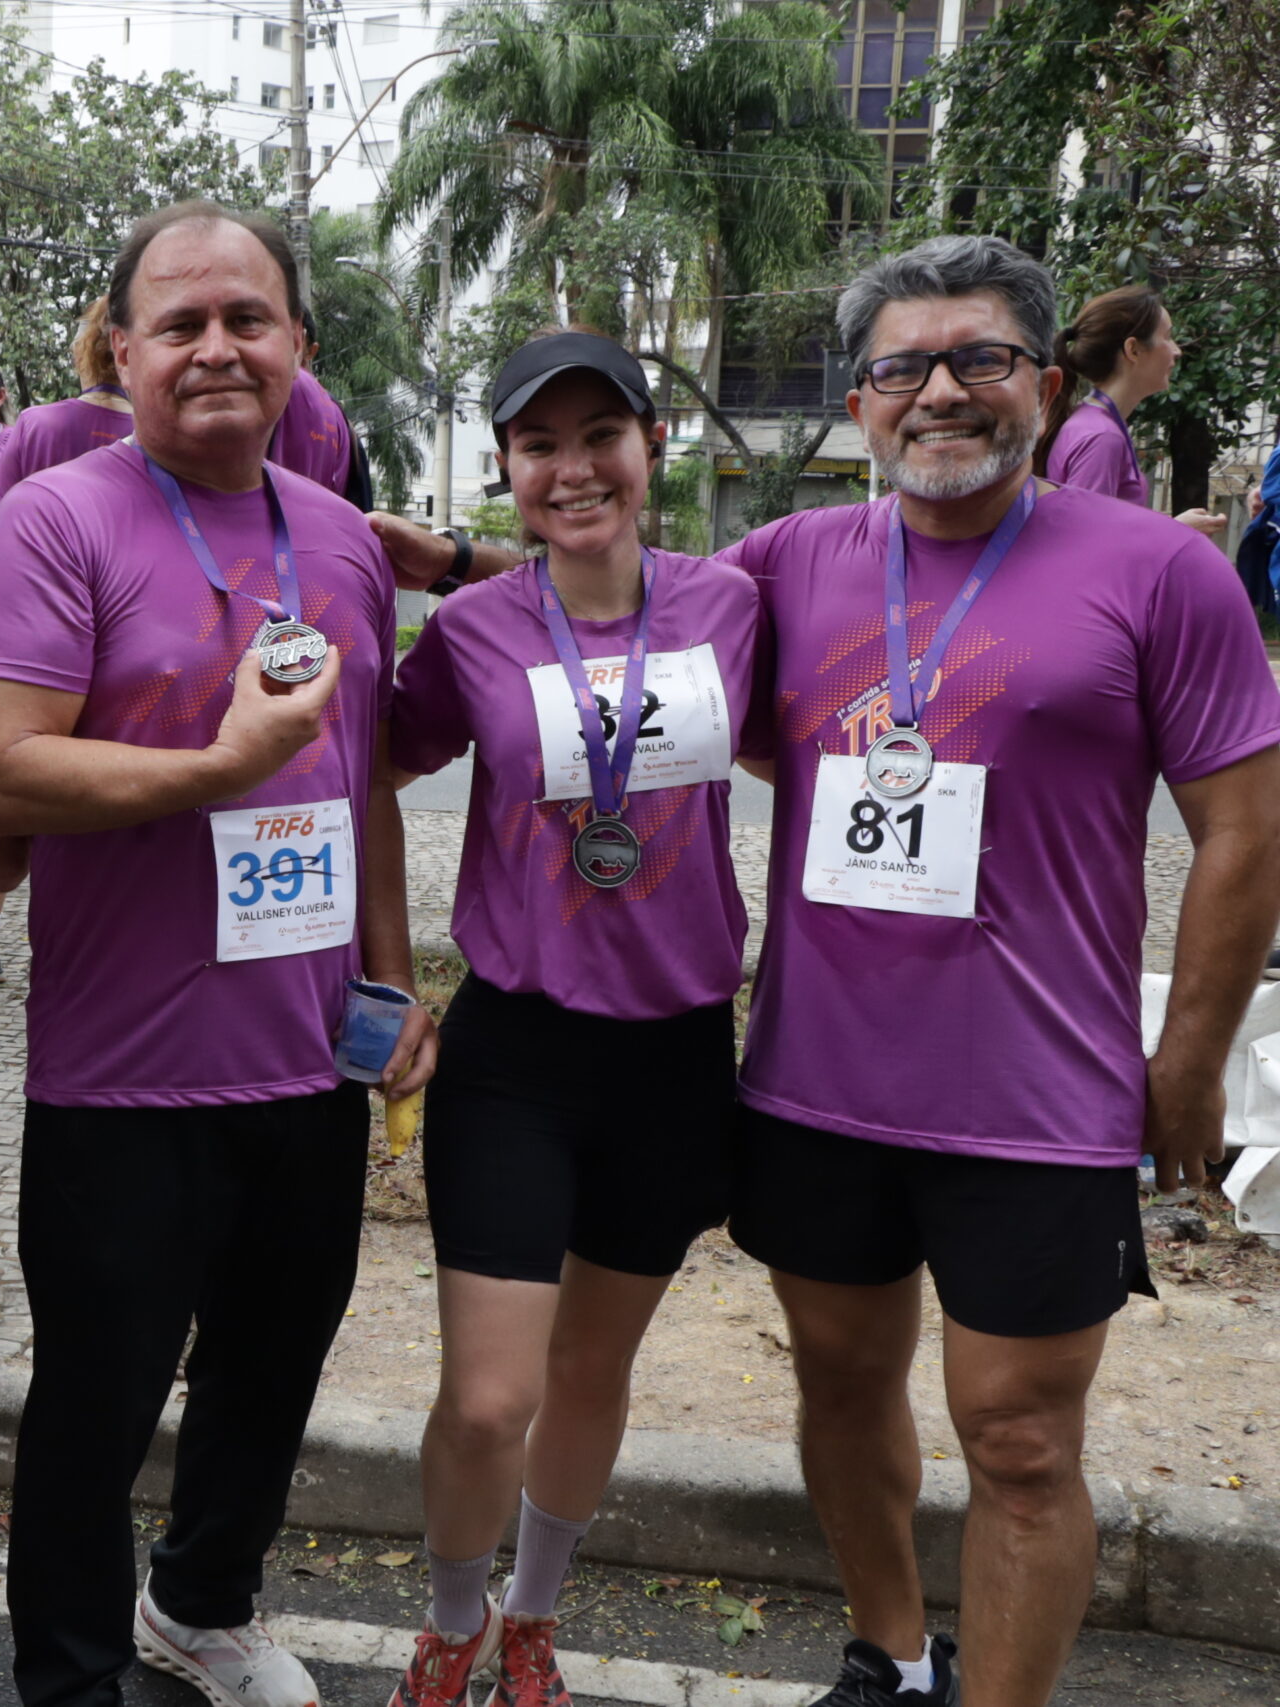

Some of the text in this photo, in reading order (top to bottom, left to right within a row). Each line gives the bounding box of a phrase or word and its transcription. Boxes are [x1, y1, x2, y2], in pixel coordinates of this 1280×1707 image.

[259, 638, 328, 671] TRF6
[847, 686, 880, 712] corrida
[937, 788, 957, 797] 5KM
[254, 815, 315, 841] TRF6
[846, 799, 924, 859] 81
[227, 842, 334, 908] 391
[880, 861, 927, 875] SANTOS
[236, 901, 335, 922] VALLISNEY OLIVEIRA
